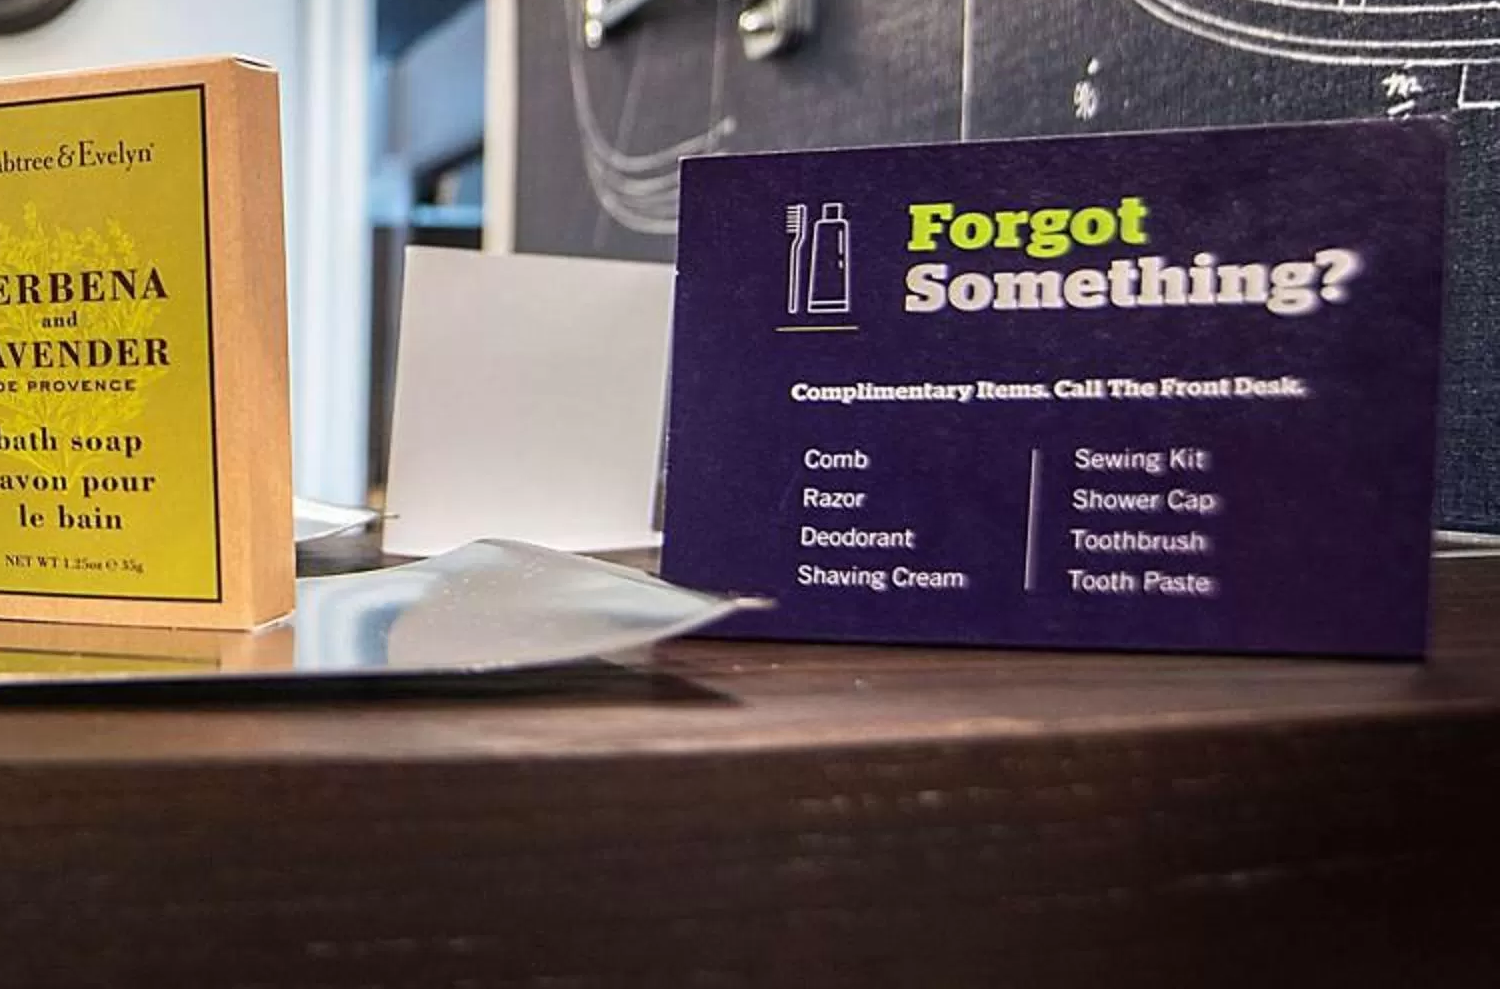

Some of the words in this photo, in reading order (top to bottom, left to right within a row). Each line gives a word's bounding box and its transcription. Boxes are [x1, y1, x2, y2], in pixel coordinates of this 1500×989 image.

[57, 145, 74, 167] &
[79, 140, 151, 171] Evelyn
[906, 197, 1149, 258] Forgot
[904, 249, 1358, 315] Something?
[41, 312, 77, 328] and
[28, 379, 135, 392] PROVENCE
[791, 381, 973, 404] Complimentary
[975, 381, 1050, 400] Items.
[1053, 378, 1103, 399] Call
[1107, 378, 1157, 398] The
[1160, 377, 1230, 398] Front
[1232, 376, 1304, 397] Desk.
[71, 434, 142, 457] soap
[804, 448, 869, 470] Comb
[1073, 448, 1163, 473] Sewing
[1168, 448, 1207, 470] Kit
[82, 475, 156, 497] pour
[802, 488, 866, 508] Razor
[1071, 488, 1160, 510] Shower
[1167, 489, 1215, 515] Cap
[19, 503, 44, 528] le
[58, 505, 122, 530] bain
[800, 527, 915, 548] Deodorant
[1069, 528, 1209, 552] Toothbrush
[5, 554, 32, 567] NET
[37, 556, 59, 568] WT
[797, 565, 886, 592] Shaving
[891, 567, 966, 589] Cream
[1067, 569, 1135, 592] Tooth
[1143, 570, 1214, 594] Paste
